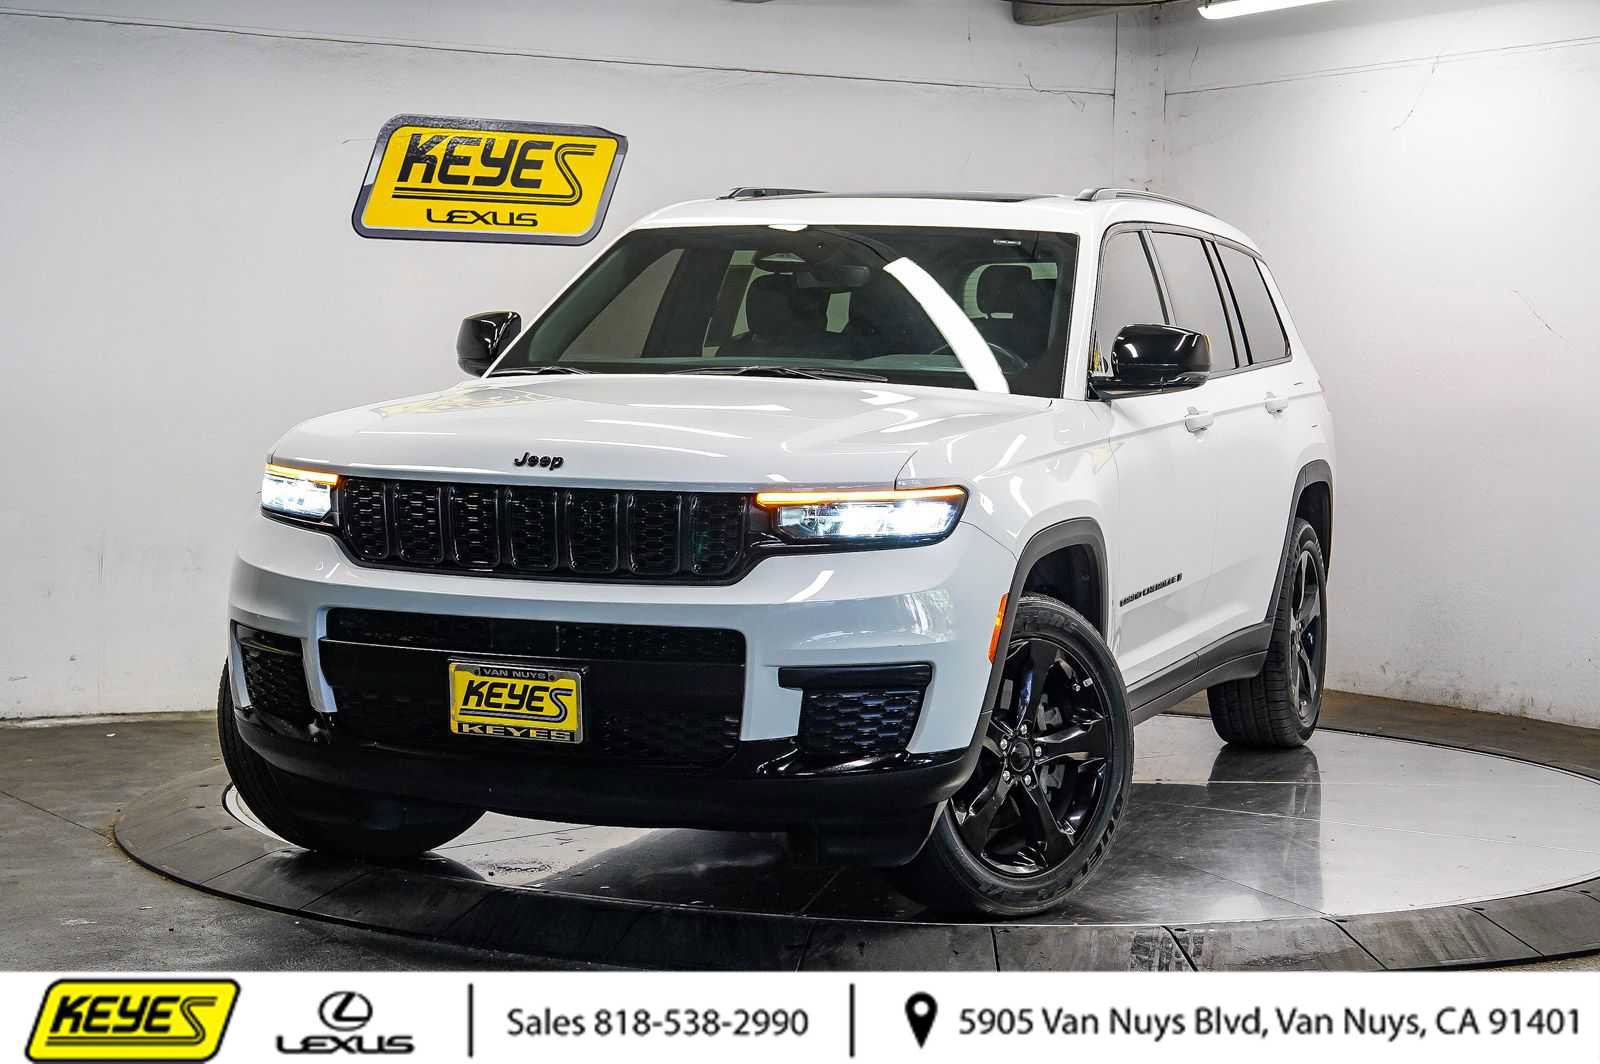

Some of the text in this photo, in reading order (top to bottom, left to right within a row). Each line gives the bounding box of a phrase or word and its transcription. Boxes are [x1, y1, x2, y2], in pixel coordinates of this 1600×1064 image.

[392, 132, 596, 206] KEYES
[426, 208, 538, 227] LEXUS
[514, 452, 564, 471] Jeep
[483, 667, 547, 680] VAN NUYS
[459, 680, 573, 723] KEYES
[462, 723, 571, 740] KEYES
